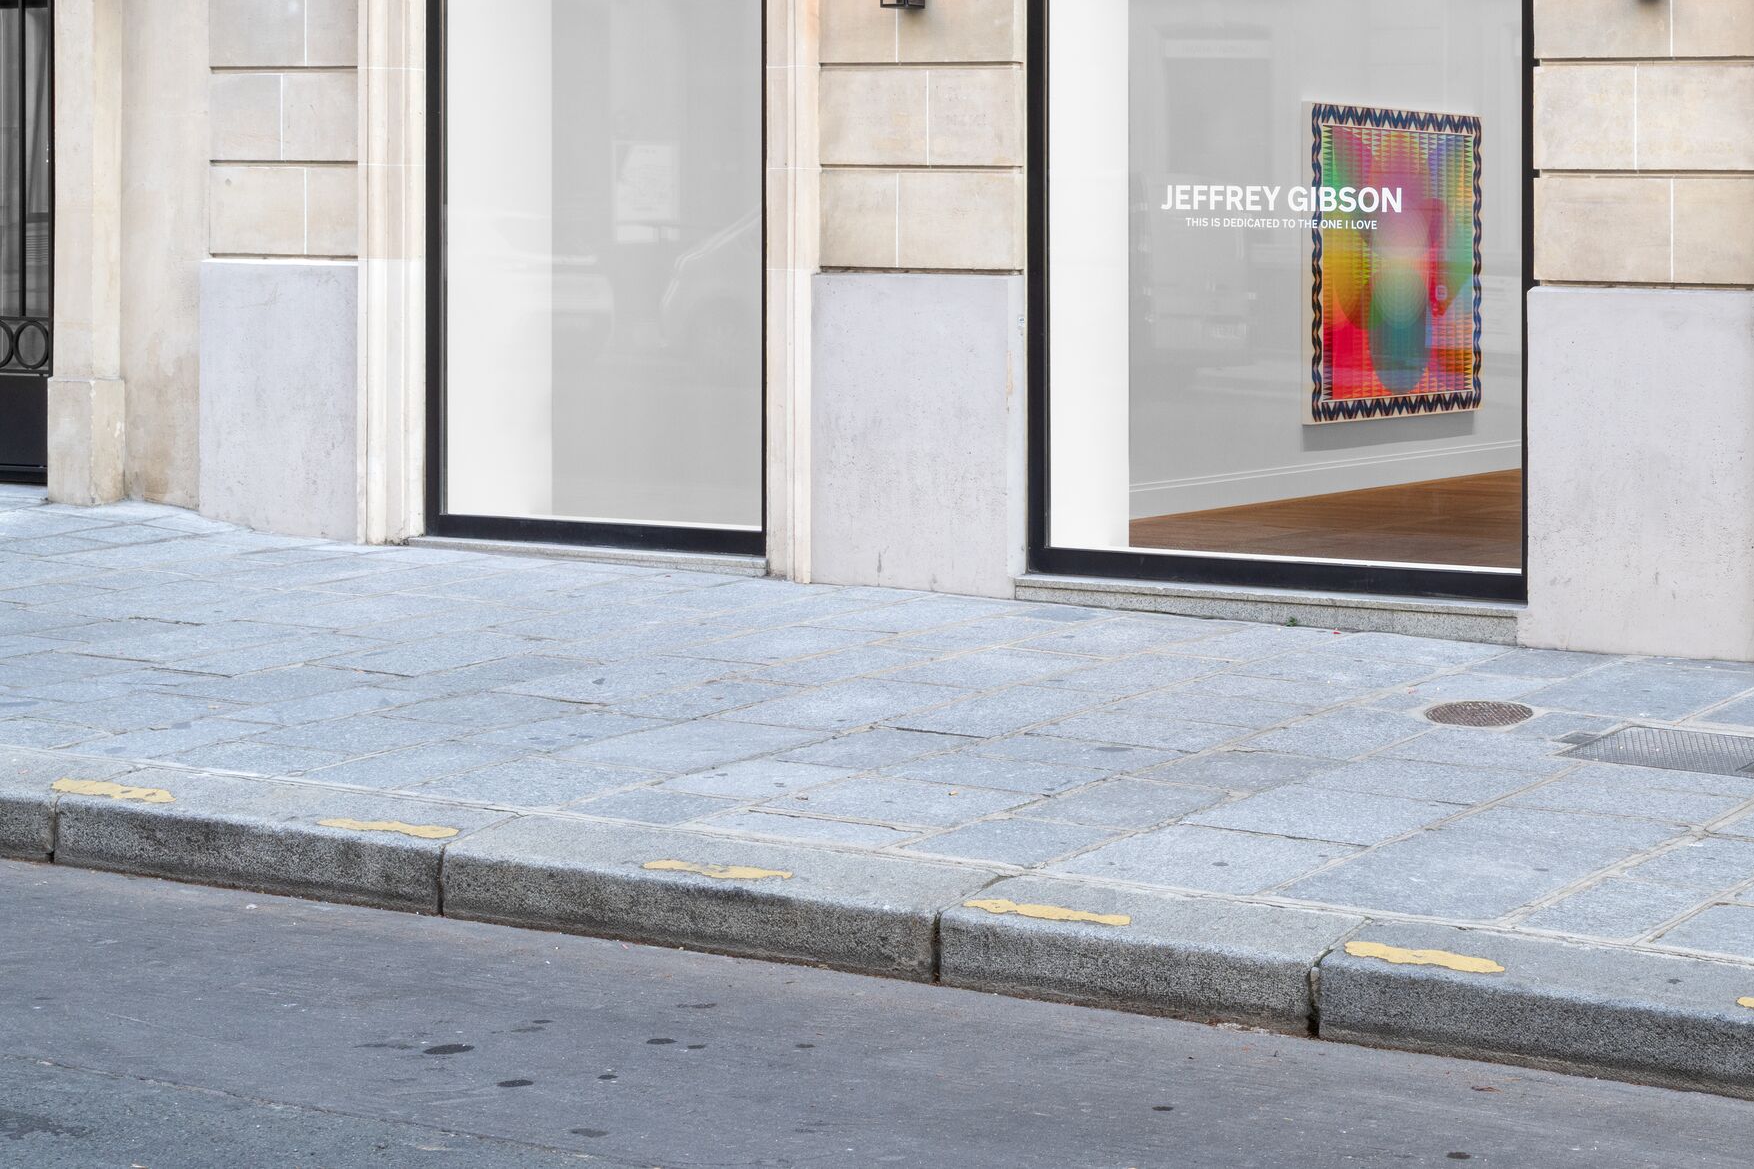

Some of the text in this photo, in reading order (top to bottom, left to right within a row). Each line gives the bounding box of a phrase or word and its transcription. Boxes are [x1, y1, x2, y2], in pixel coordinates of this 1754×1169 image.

[1160, 184, 1402, 213] JEFFREY GIBSON
[1185, 217, 1209, 228] THIS
[1211, 217, 1221, 228] IS
[1223, 217, 1280, 229] DEDICATED
[1281, 218, 1296, 229] TO
[1298, 219, 1318, 229] THE
[1321, 219, 1343, 229] ONE
[1351, 220, 1377, 230] LOVE
